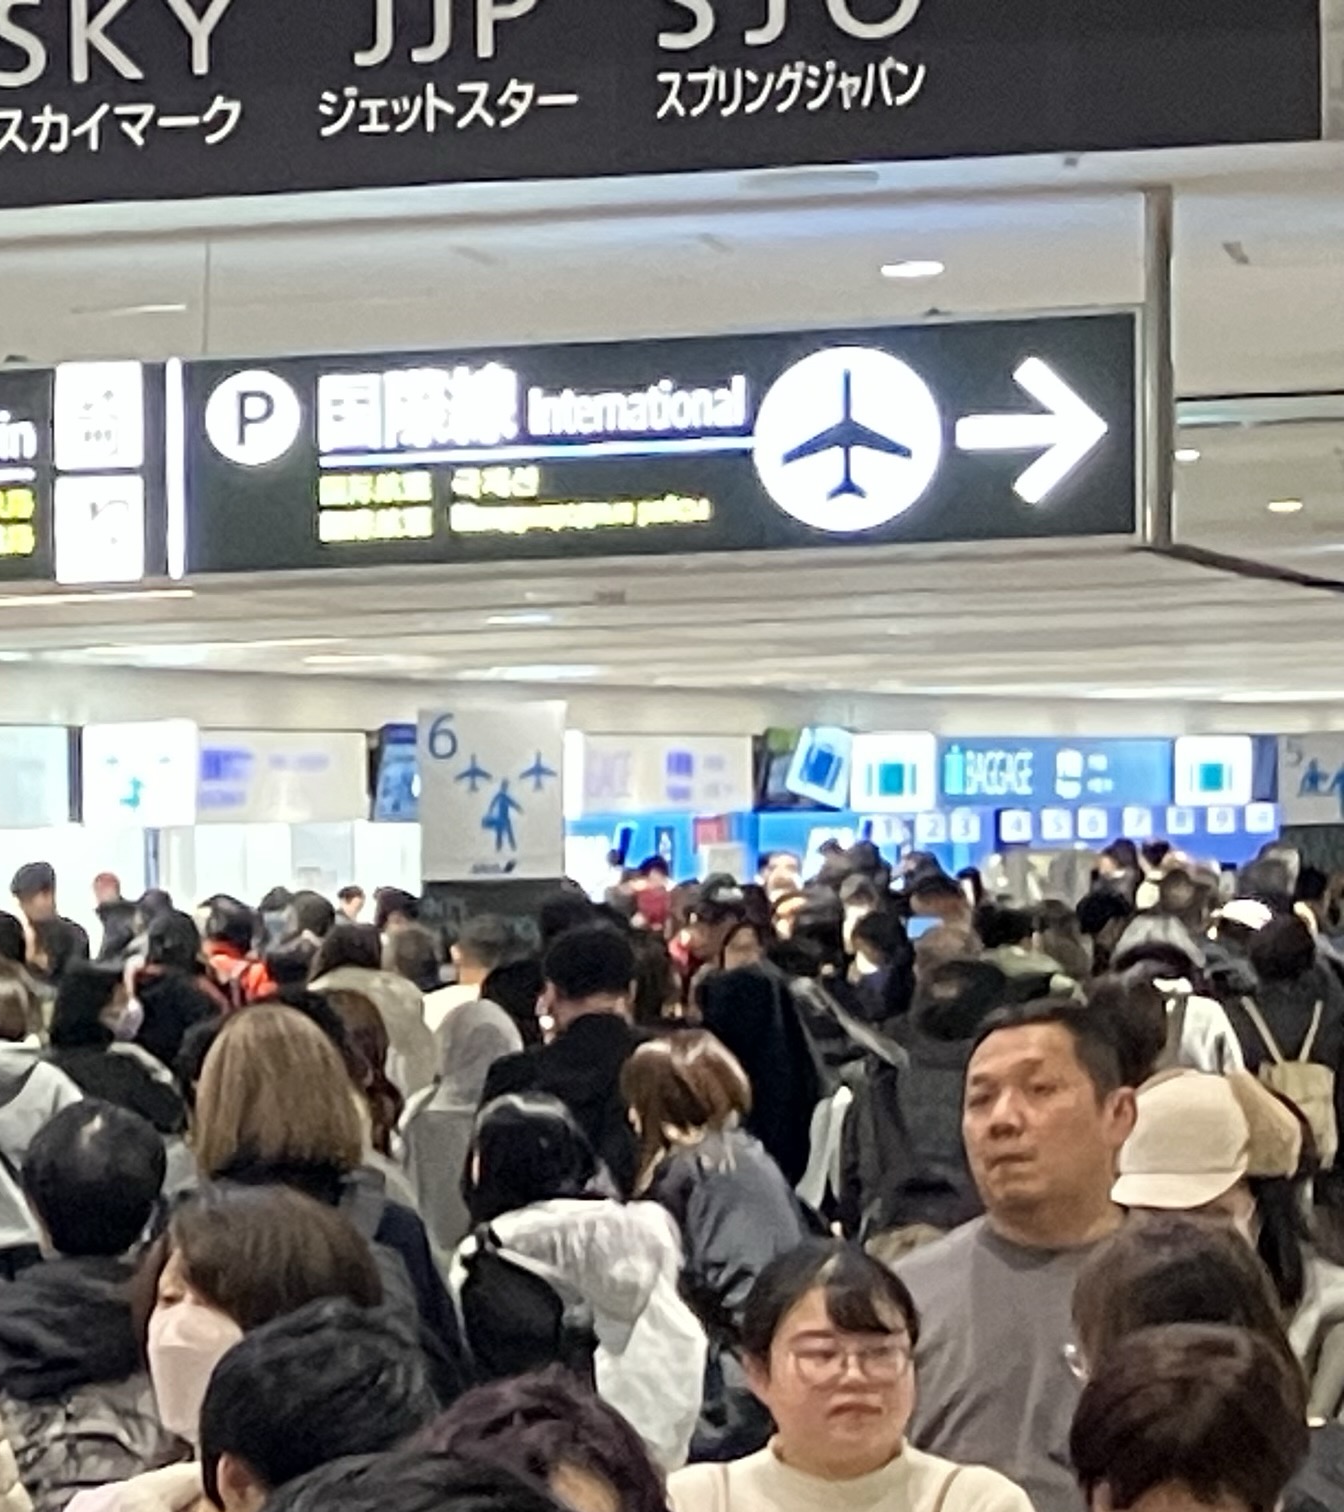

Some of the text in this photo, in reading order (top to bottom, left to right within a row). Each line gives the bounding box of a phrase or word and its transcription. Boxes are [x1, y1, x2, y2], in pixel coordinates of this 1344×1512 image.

[318, 78, 579, 137] ジェットスター
[656, 56, 926, 119] スプリングジャパン
[237, 391, 275, 446] P
[527, 375, 746, 435] International
[428, 712, 457, 760] 6
